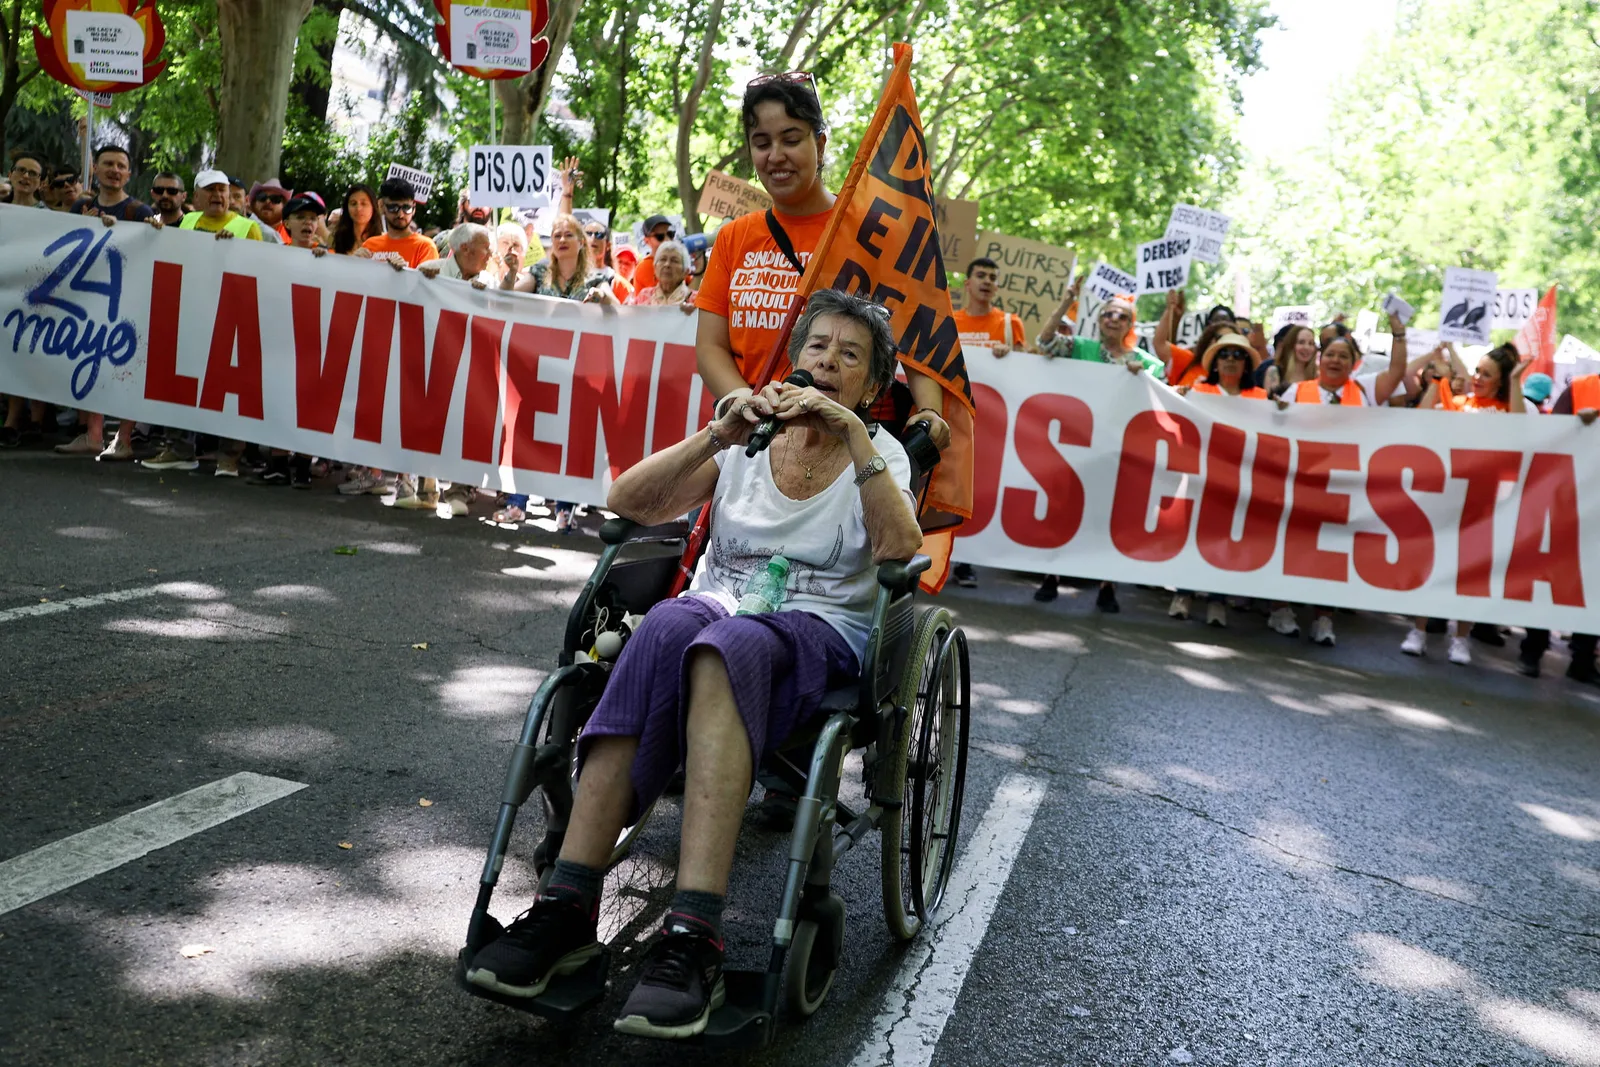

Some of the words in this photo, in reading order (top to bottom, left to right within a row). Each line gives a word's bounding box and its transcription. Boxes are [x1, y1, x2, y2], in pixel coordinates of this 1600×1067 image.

[391, 166, 432, 186] DERECHO
[708, 175, 740, 195] FUERA
[1143, 238, 1190, 263] DERECHO
[27, 227, 123, 323] 24
[735, 272, 755, 286] DE
[1097, 265, 1138, 293] DERECHO
[1146, 272, 1154, 289] A
[732, 310, 743, 328] DE
[3, 308, 137, 400] mayo
[144, 260, 264, 420] LA
[1109, 409, 1587, 608] CUESTA
